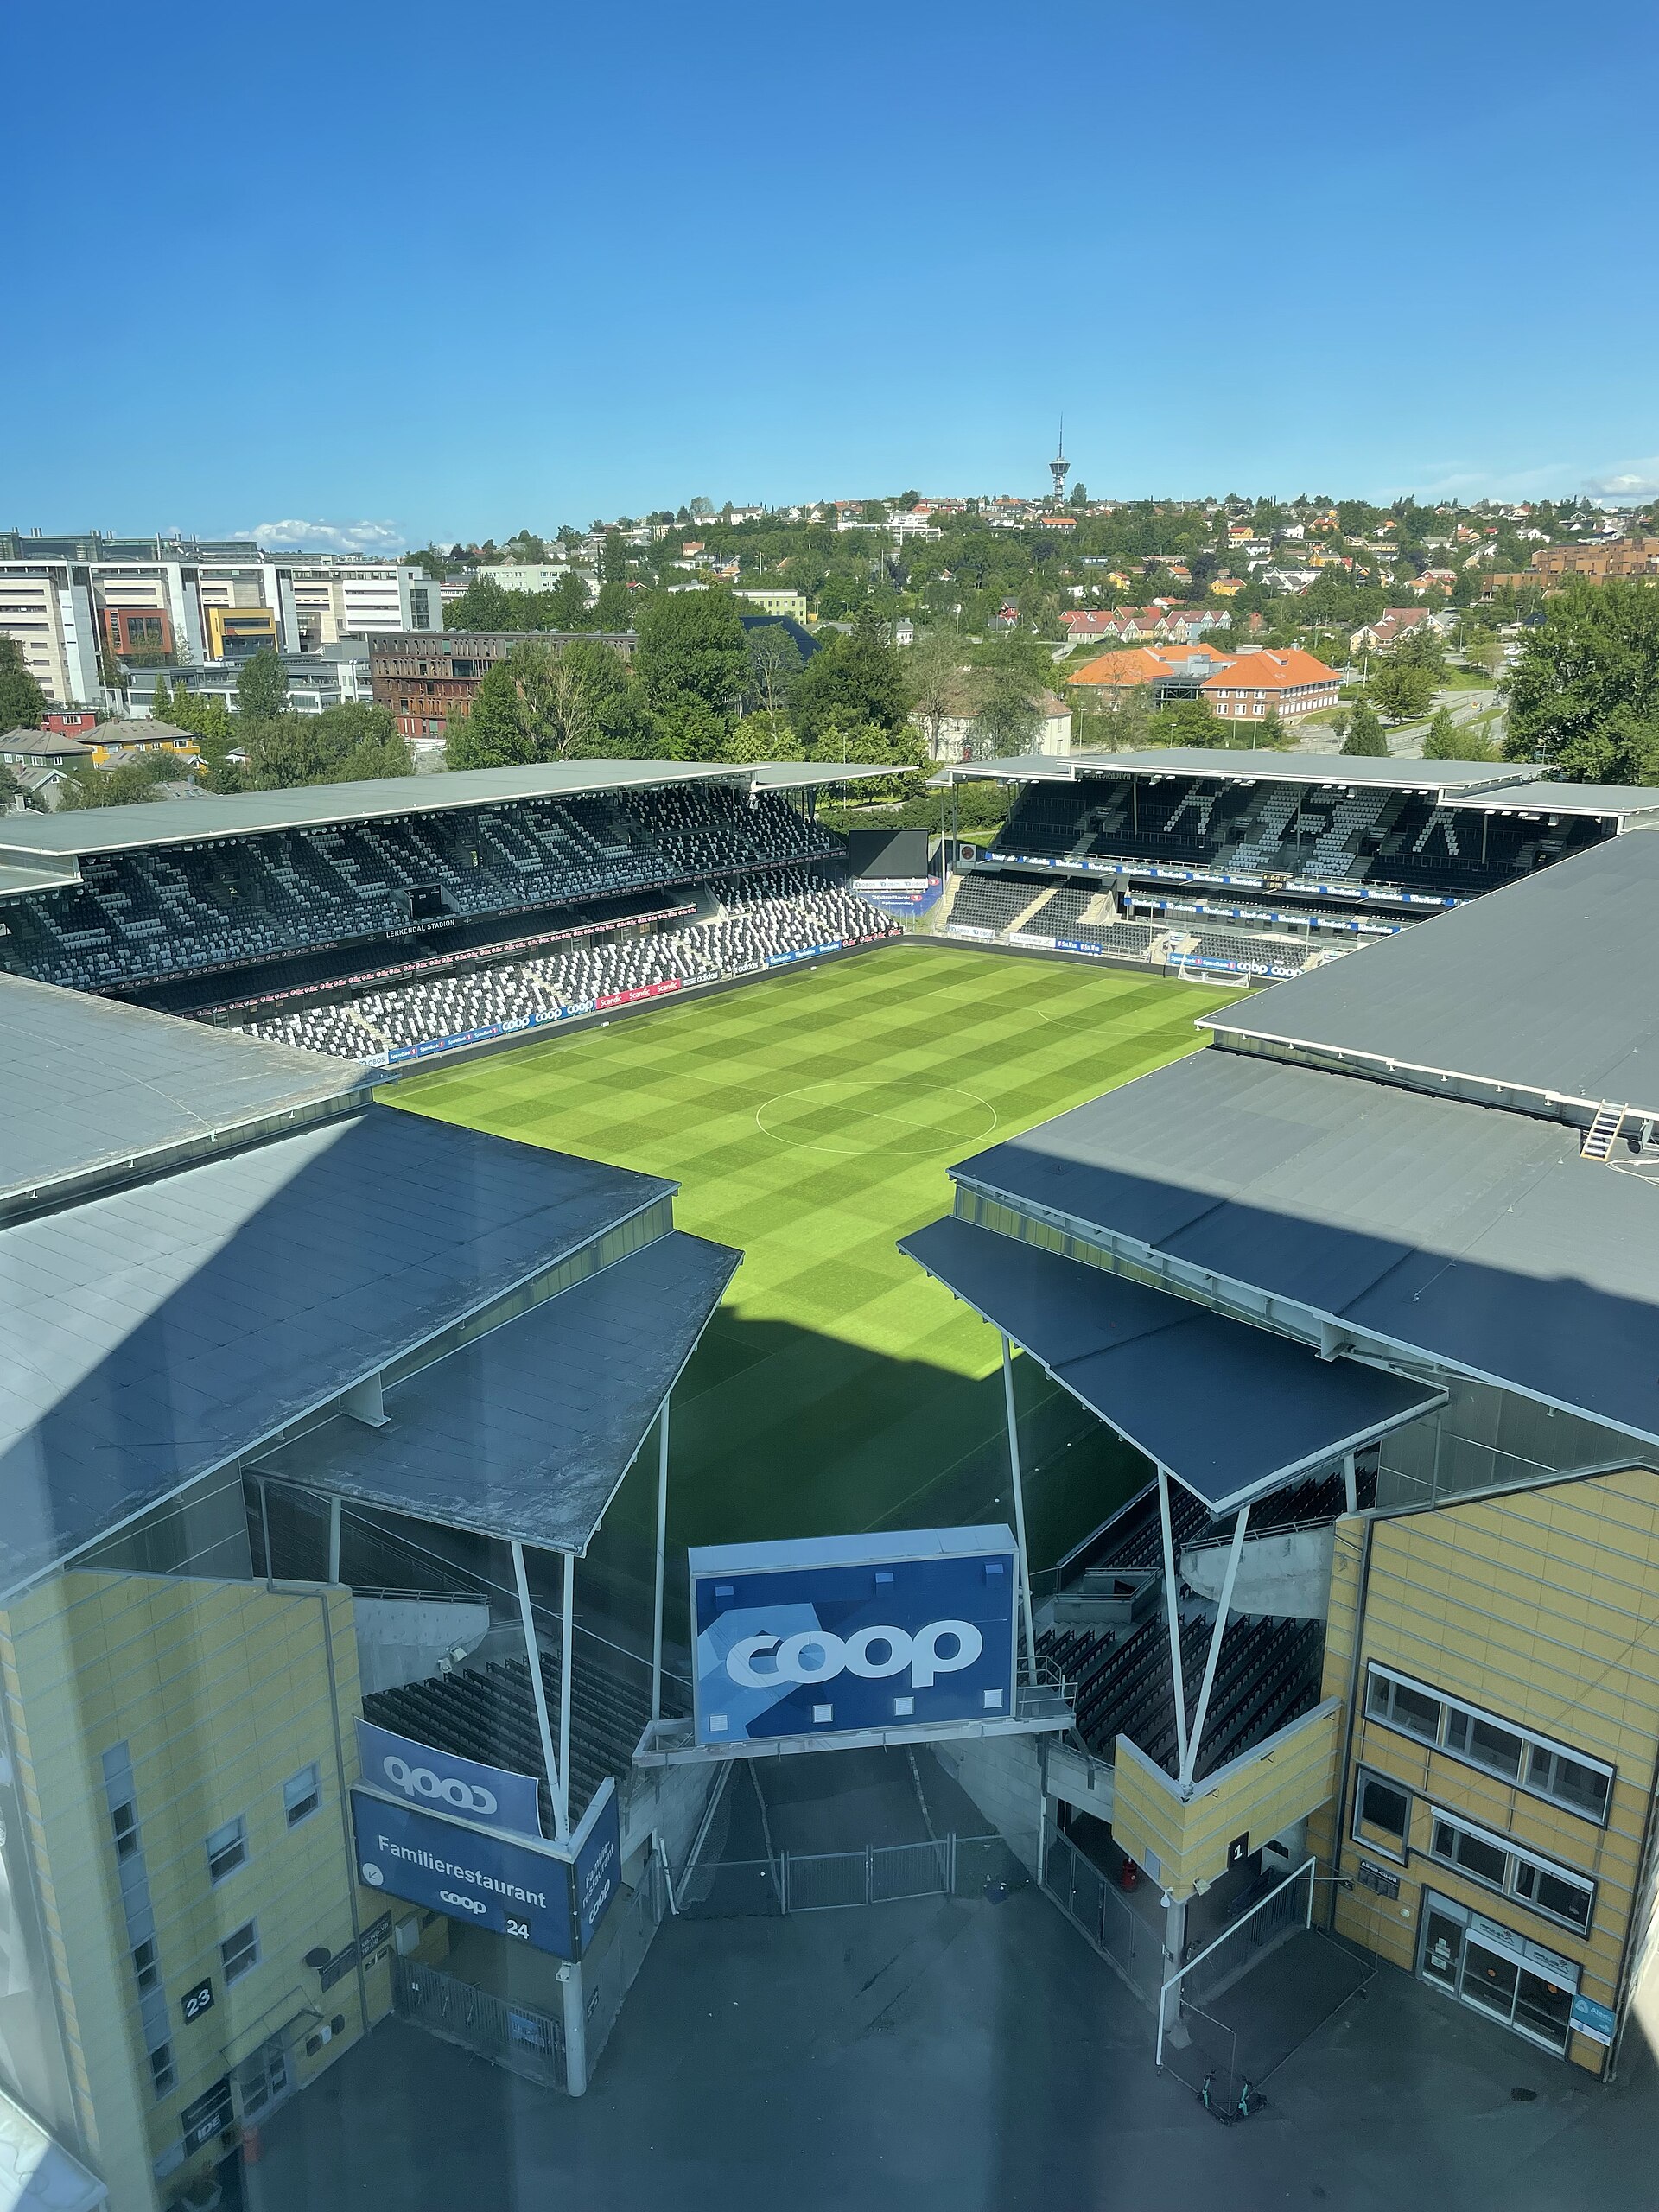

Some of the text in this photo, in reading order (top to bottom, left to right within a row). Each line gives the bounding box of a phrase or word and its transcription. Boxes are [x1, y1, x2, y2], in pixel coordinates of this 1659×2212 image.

[385, 918, 455, 938] LERKENDAL STADION
[696, 972, 719, 983] adidas
[737, 962, 759, 973] adidas
[600, 982, 678, 1007] Scandic Scandic Scandic
[502, 999, 594, 1031] coop coop coop
[368, 1057, 385, 1066] OBOS
[726, 1619, 983, 1688] coop
[1233, 1844, 1243, 1860] 1
[378, 1834, 547, 1909] Familierestaurant
[582, 1843, 614, 1910] restaurant
[439, 1890, 486, 1915] coop
[588, 1878, 610, 1925] coop
[506, 1919, 530, 1939] 24
[187, 1989, 211, 2018] 23
